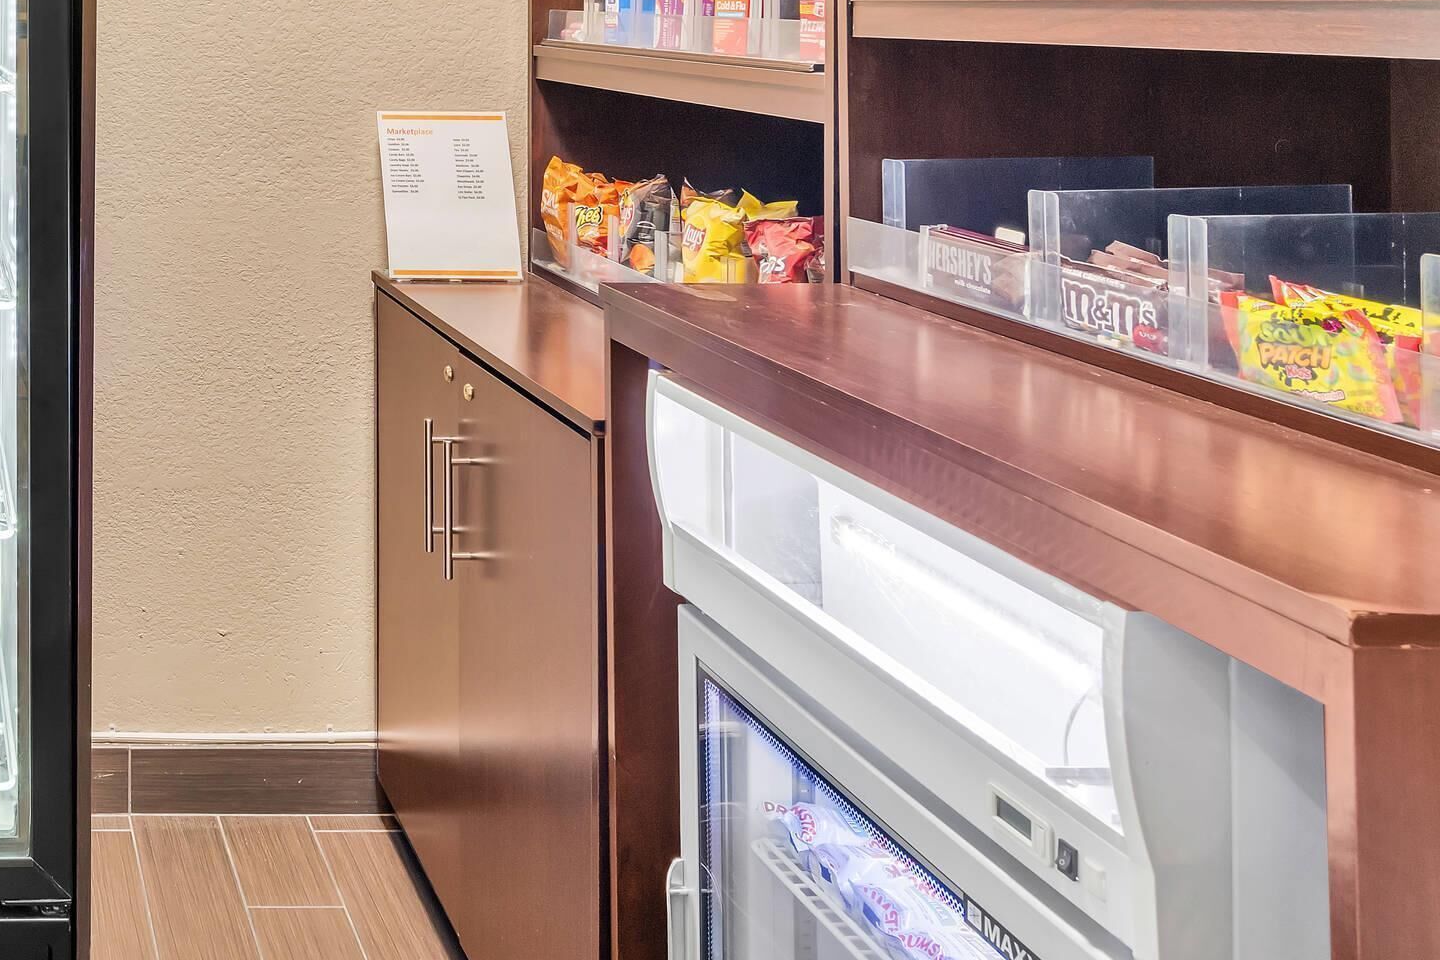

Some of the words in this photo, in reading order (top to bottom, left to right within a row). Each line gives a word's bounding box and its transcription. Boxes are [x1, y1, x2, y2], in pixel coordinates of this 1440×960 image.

[386, 128, 433, 136] Marketplace
[927, 240, 992, 285] HERSHEY'S
[1259, 343, 1333, 370] PATCH
